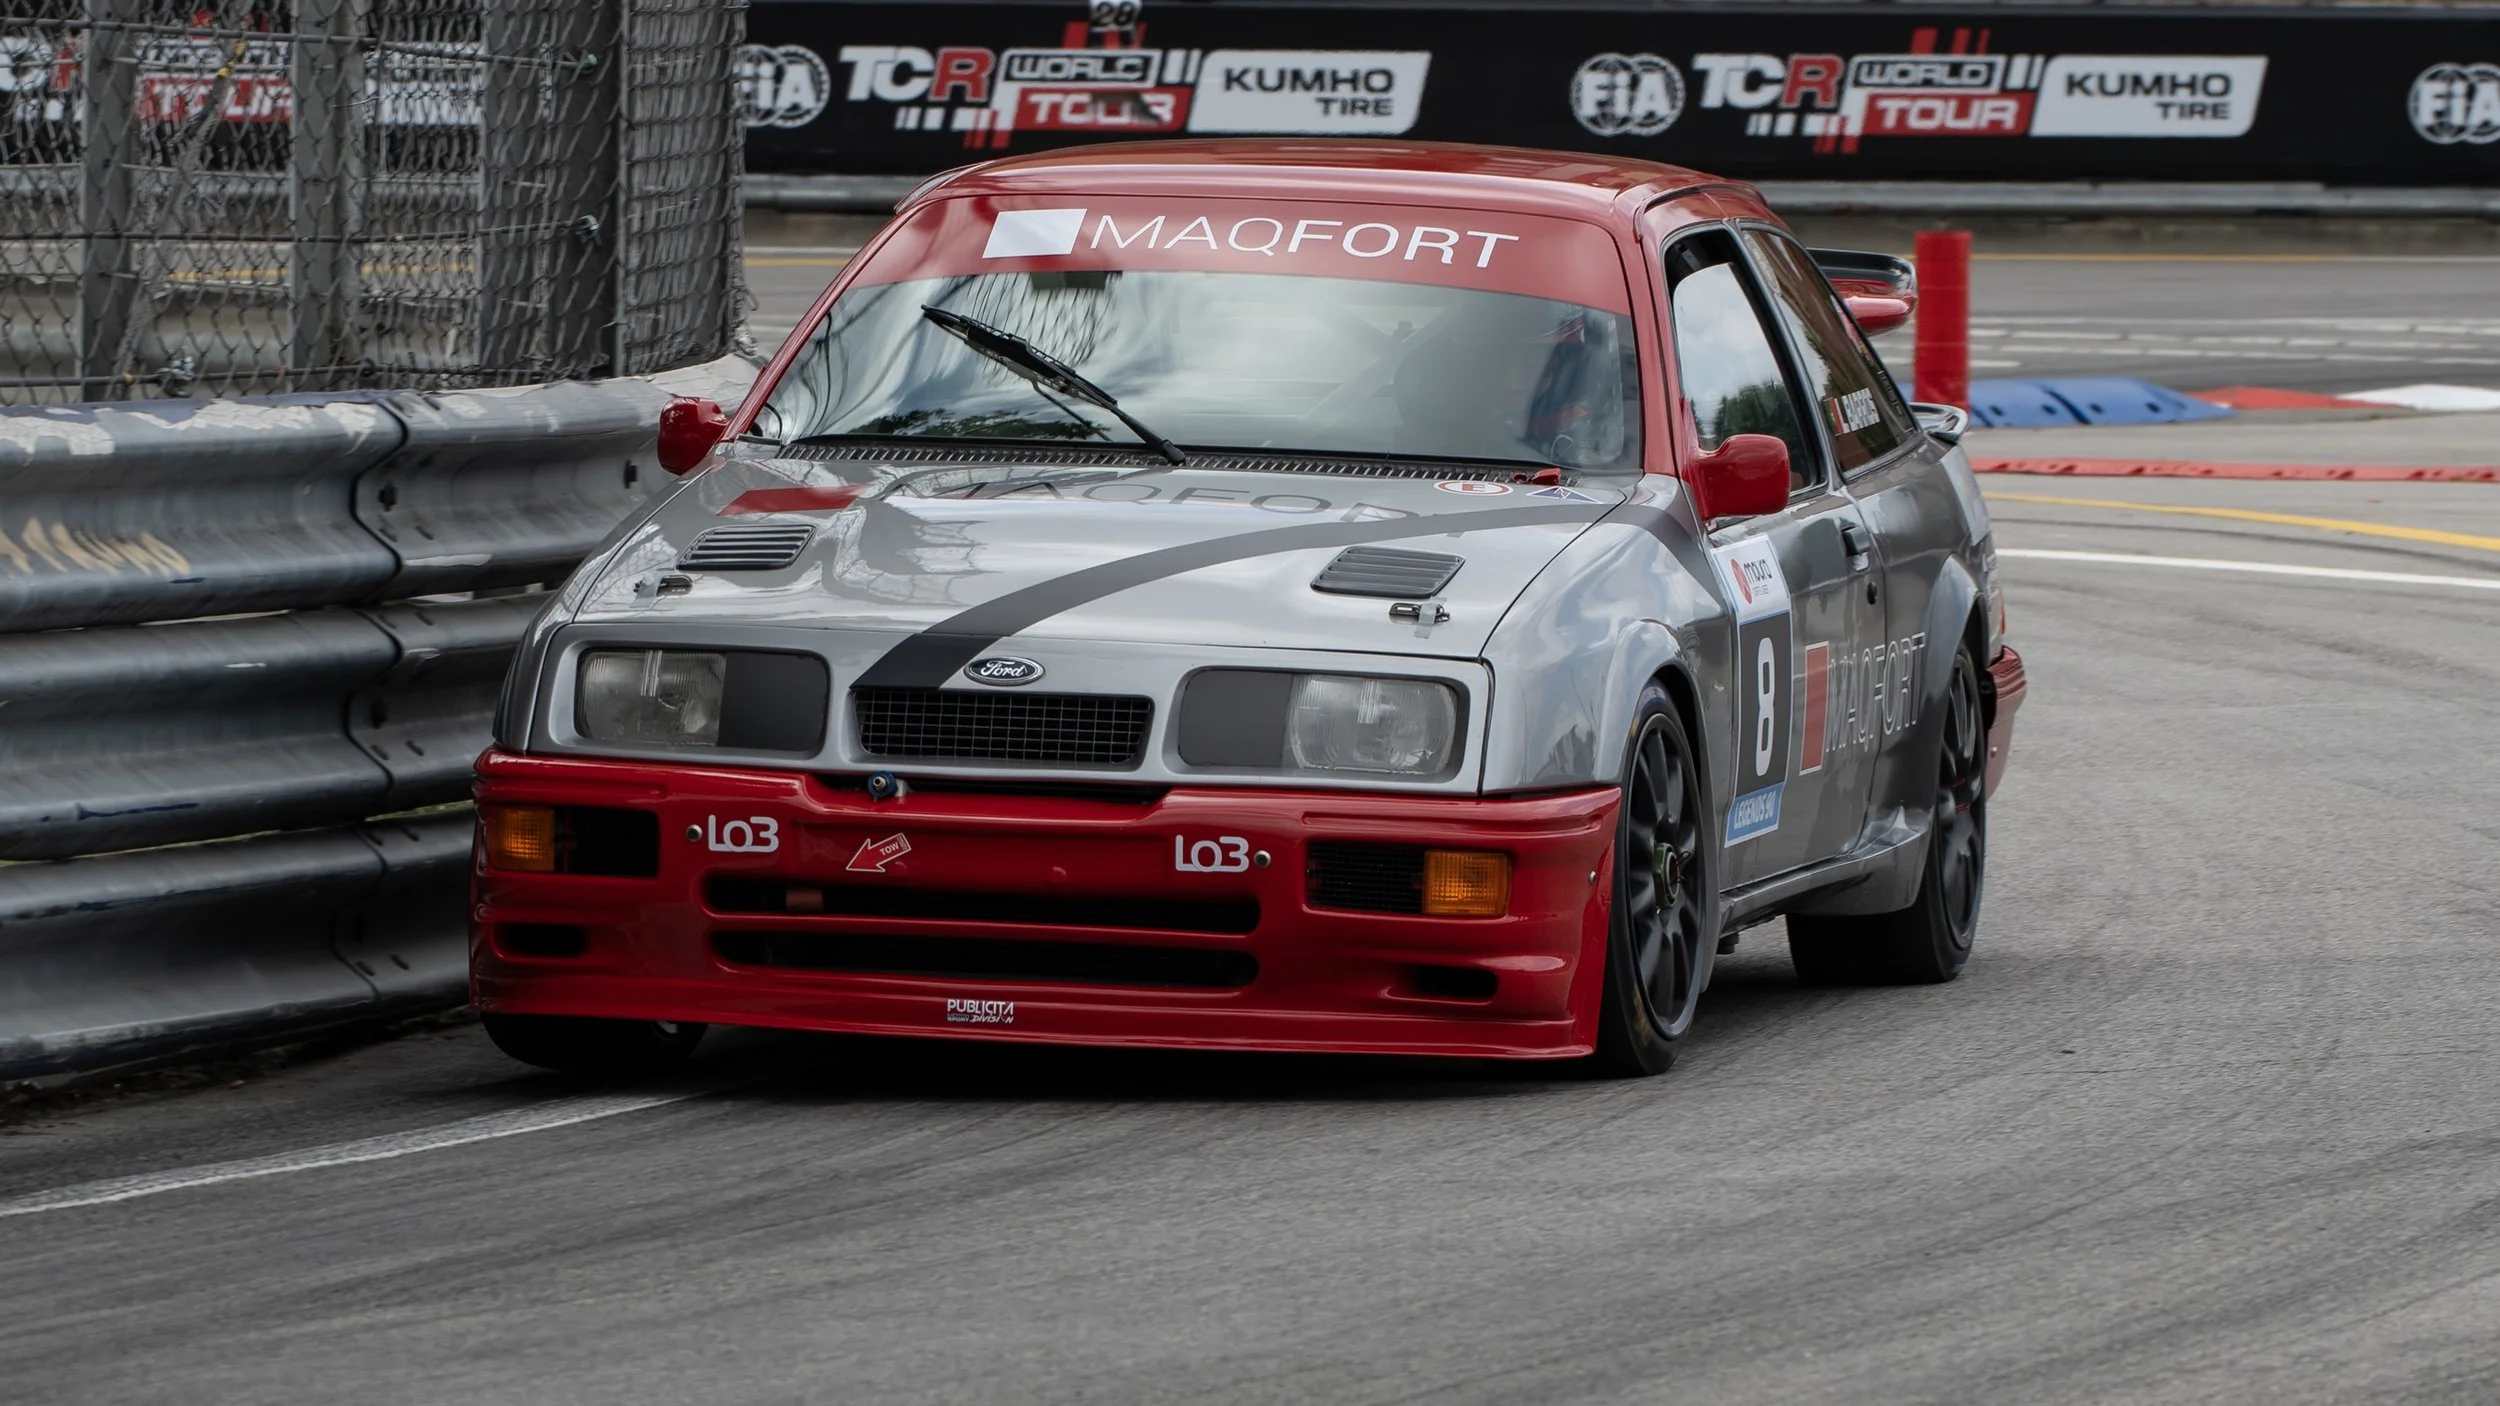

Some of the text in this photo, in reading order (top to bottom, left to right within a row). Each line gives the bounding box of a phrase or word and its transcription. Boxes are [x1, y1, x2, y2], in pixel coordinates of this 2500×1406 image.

[839, 46, 995, 102] TCR
[1223, 67, 1395, 94] KUMHO
[1692, 53, 1845, 109] TCR
[1858, 63, 1991, 85] WORLD
[2065, 73, 2232, 98] KUMHO
[1314, 97, 1394, 117] TIRE
[1579, 70, 1673, 117] FIA
[2419, 80, 2500, 125] FIA
[1876, 98, 2019, 130] TOUR
[2154, 102, 2231, 120] TIRE
[1090, 214, 1519, 268] MAQFORT
[980, 660, 1028, 677] Ford
[1755, 637, 1776, 776] 8
[1825, 632, 1926, 753] MAQFORT
[880, 841, 900, 856] TOW
